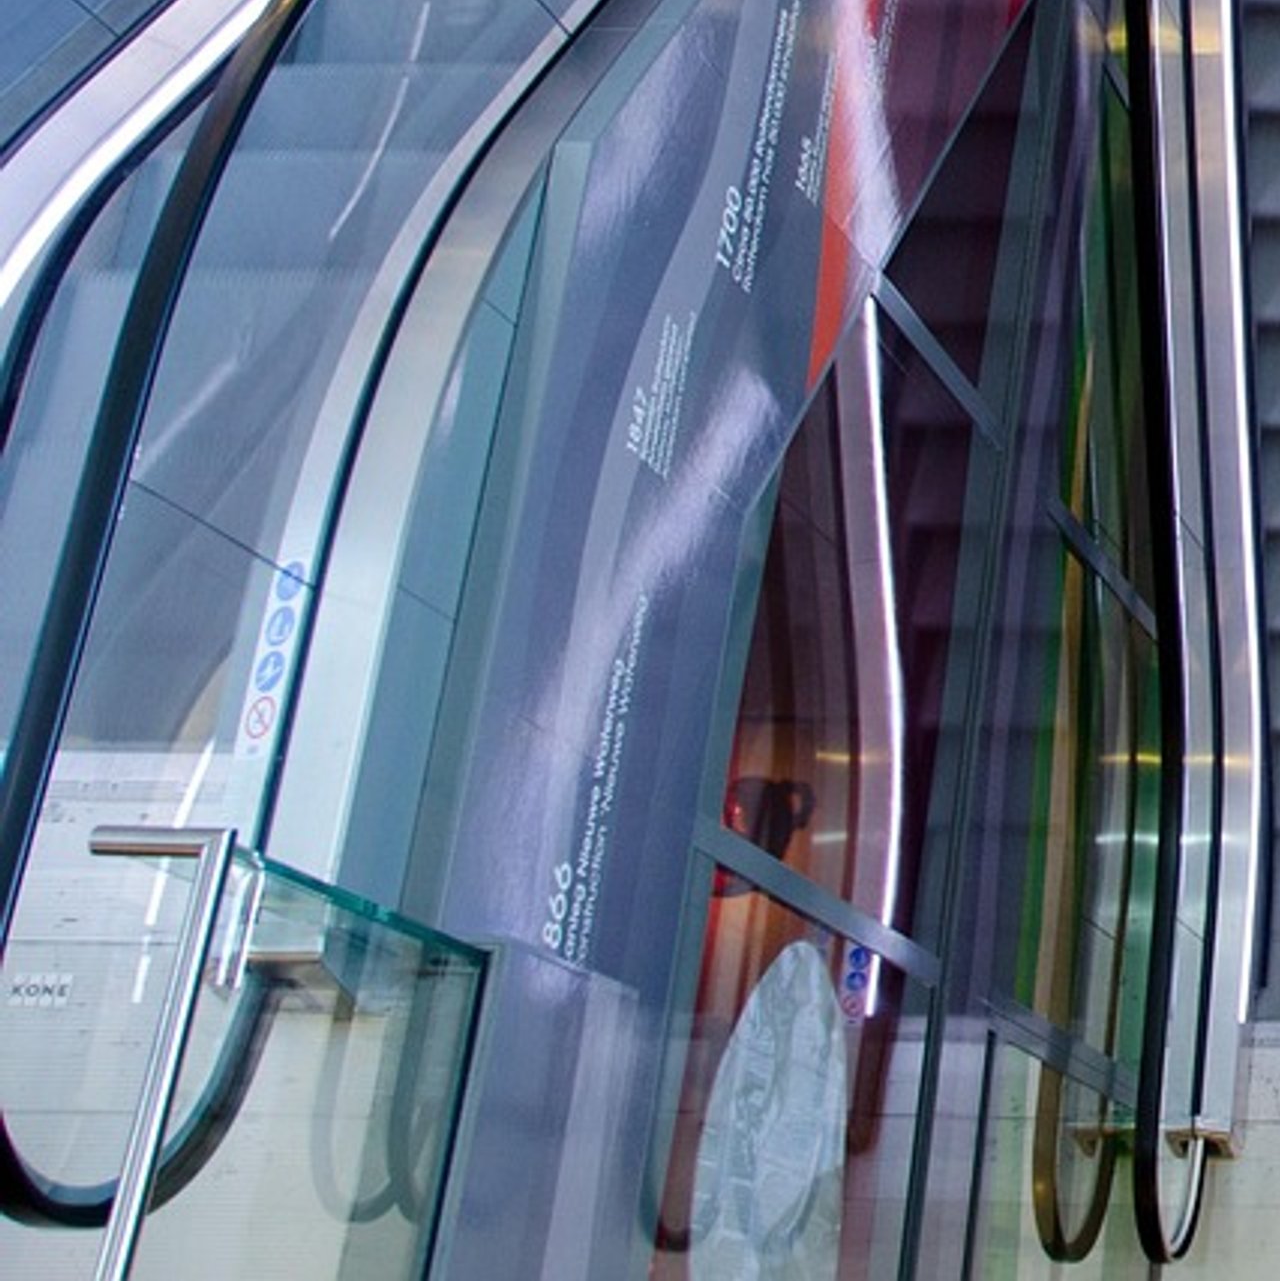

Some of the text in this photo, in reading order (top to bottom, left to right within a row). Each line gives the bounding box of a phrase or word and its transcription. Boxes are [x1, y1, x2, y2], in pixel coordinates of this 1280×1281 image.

[716, 185, 742, 269] 1700
[742, 185, 769, 293] Rotterdam
[626, 386, 646, 453] 1847
[564, 659, 625, 960] anleg Nieuwe Waterweg
[543, 862, 572, 950] 866
[576, 825, 607, 963] onstruction
[11, 983, 70, 997] KONE
